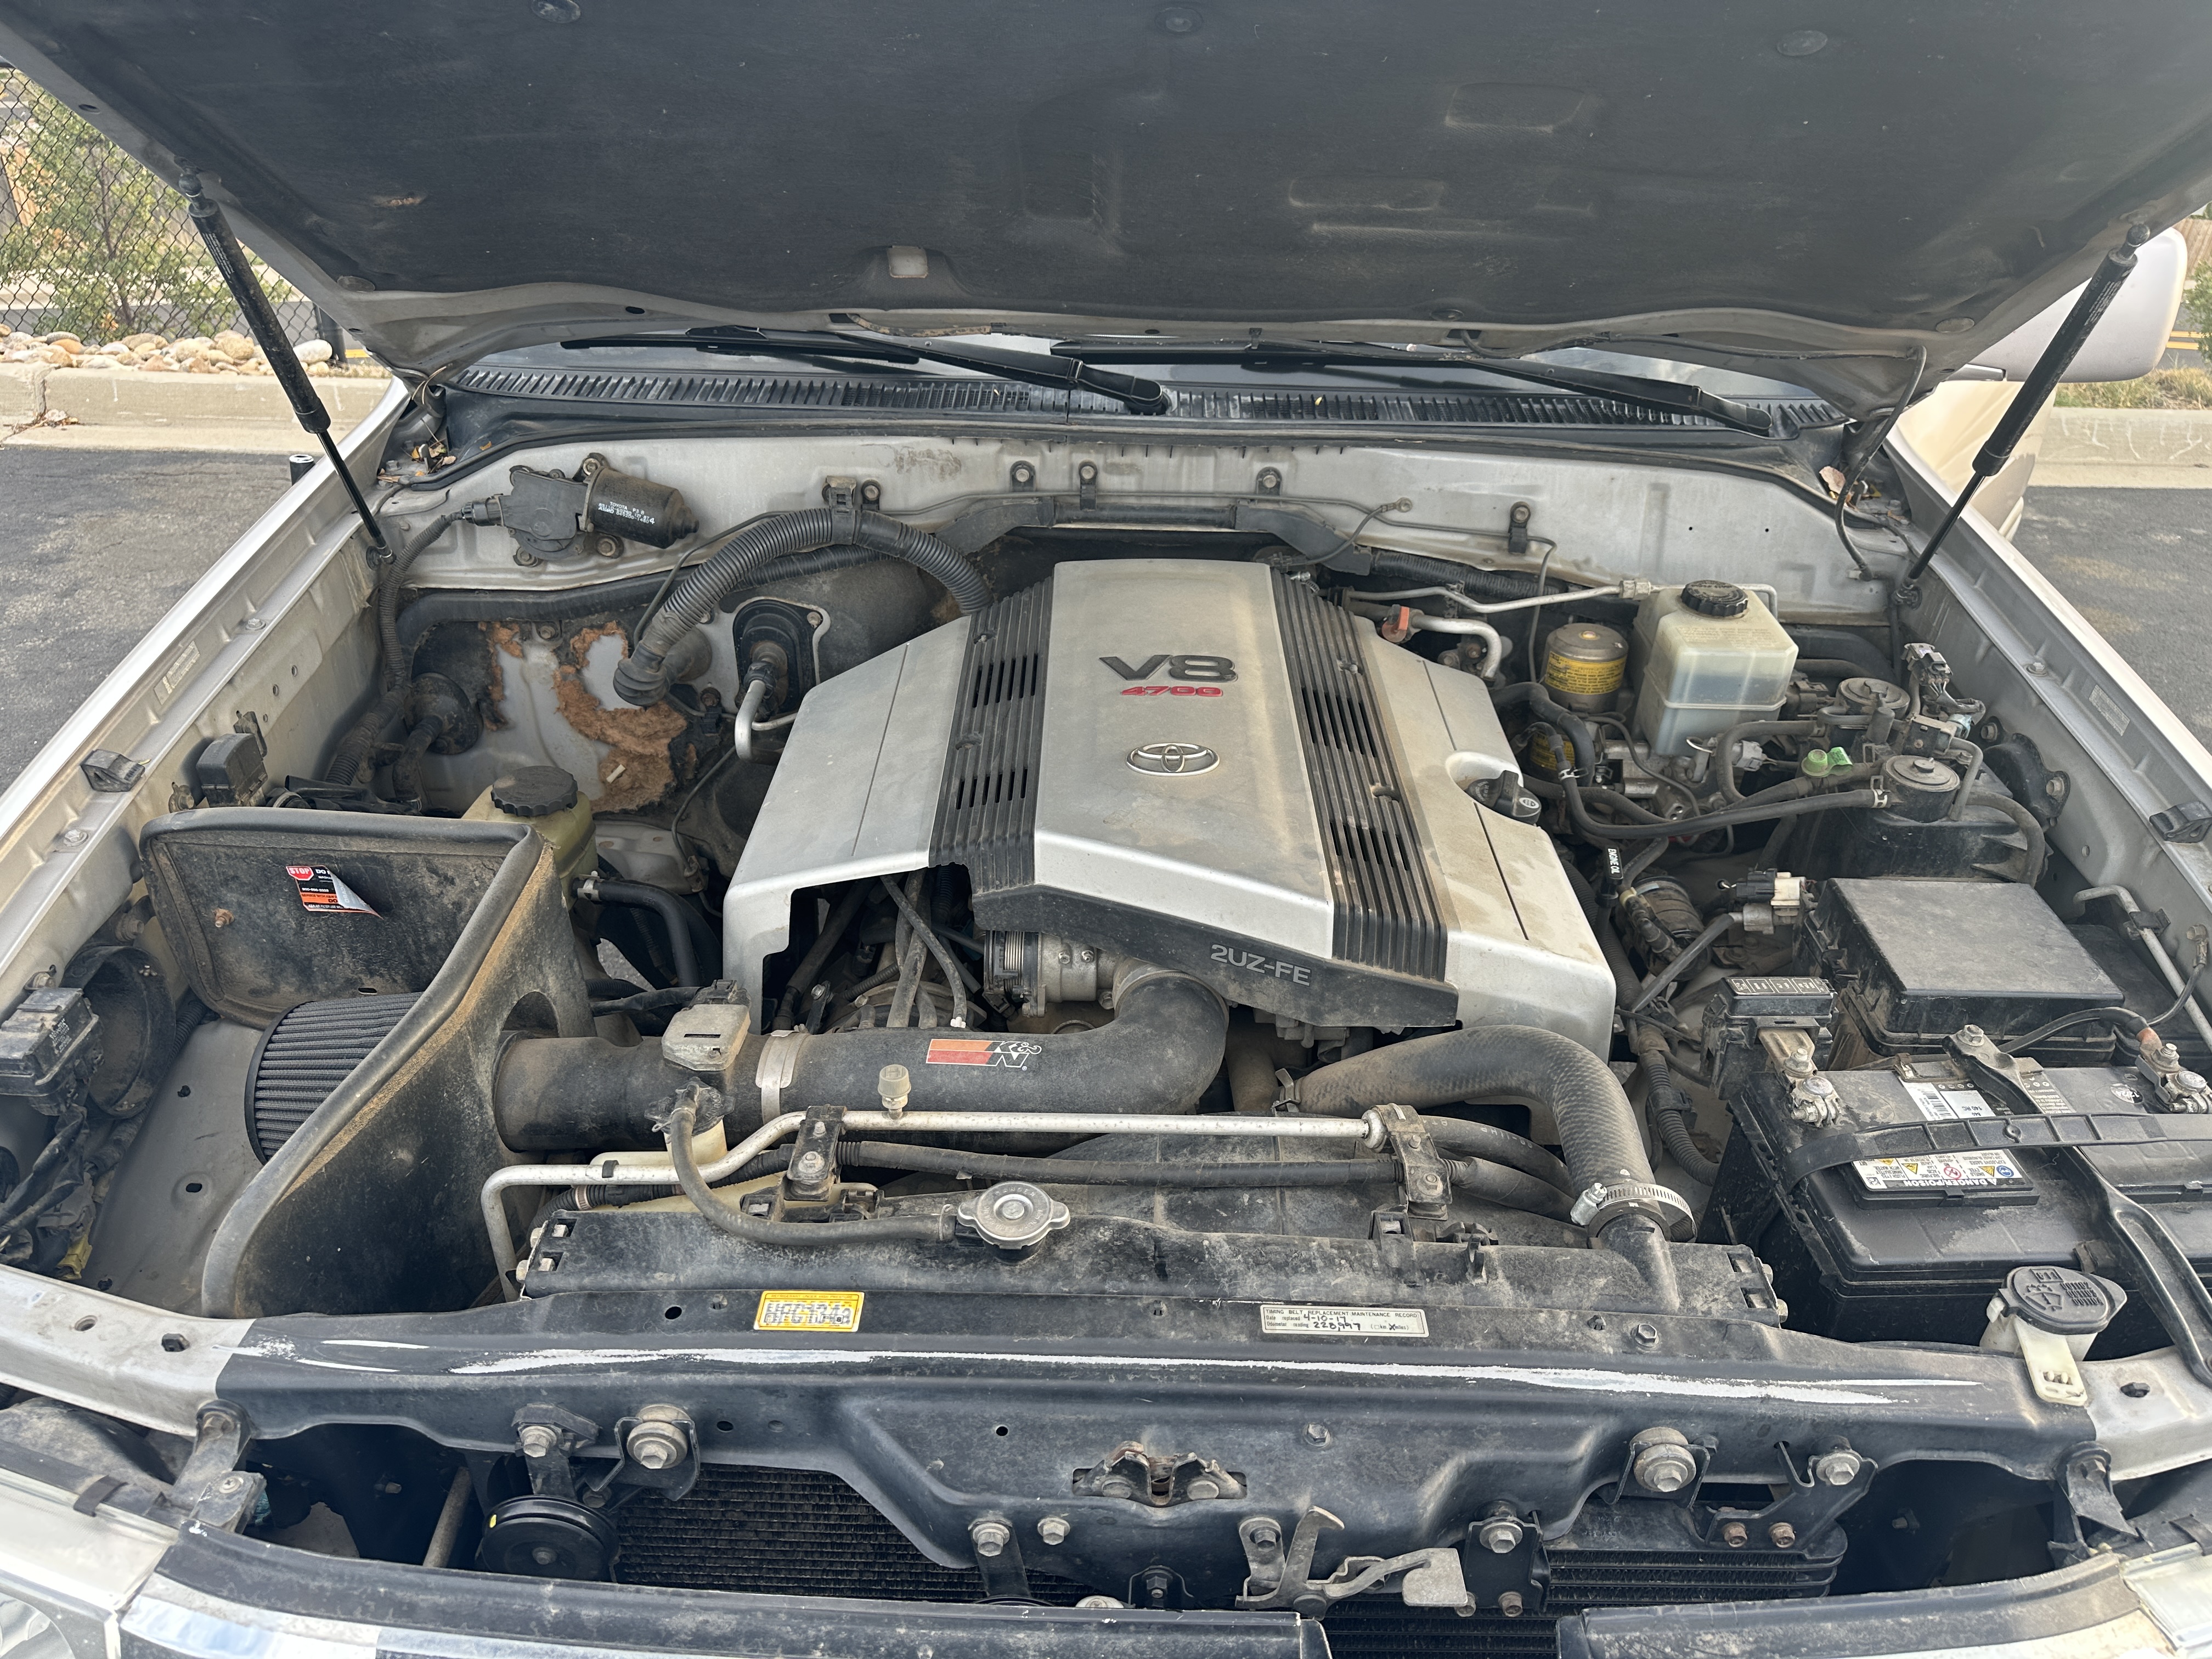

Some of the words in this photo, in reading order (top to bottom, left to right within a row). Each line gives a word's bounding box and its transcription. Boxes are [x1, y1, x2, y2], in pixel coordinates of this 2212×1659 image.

[610, 501, 628, 510] TOYOTA
[1099, 654, 1238, 682] V8
[1120, 686, 1223, 697] 4700
[1607, 848, 1619, 865] ENGINE
[1610, 866, 1620, 874] OIL
[1210, 944, 1311, 986] 2UZ-FE
[991, 1041, 1042, 1068] K&N
[995, 1187, 1036, 1197] DANGER
[1303, 1313, 1346, 1323] 4-10-17
